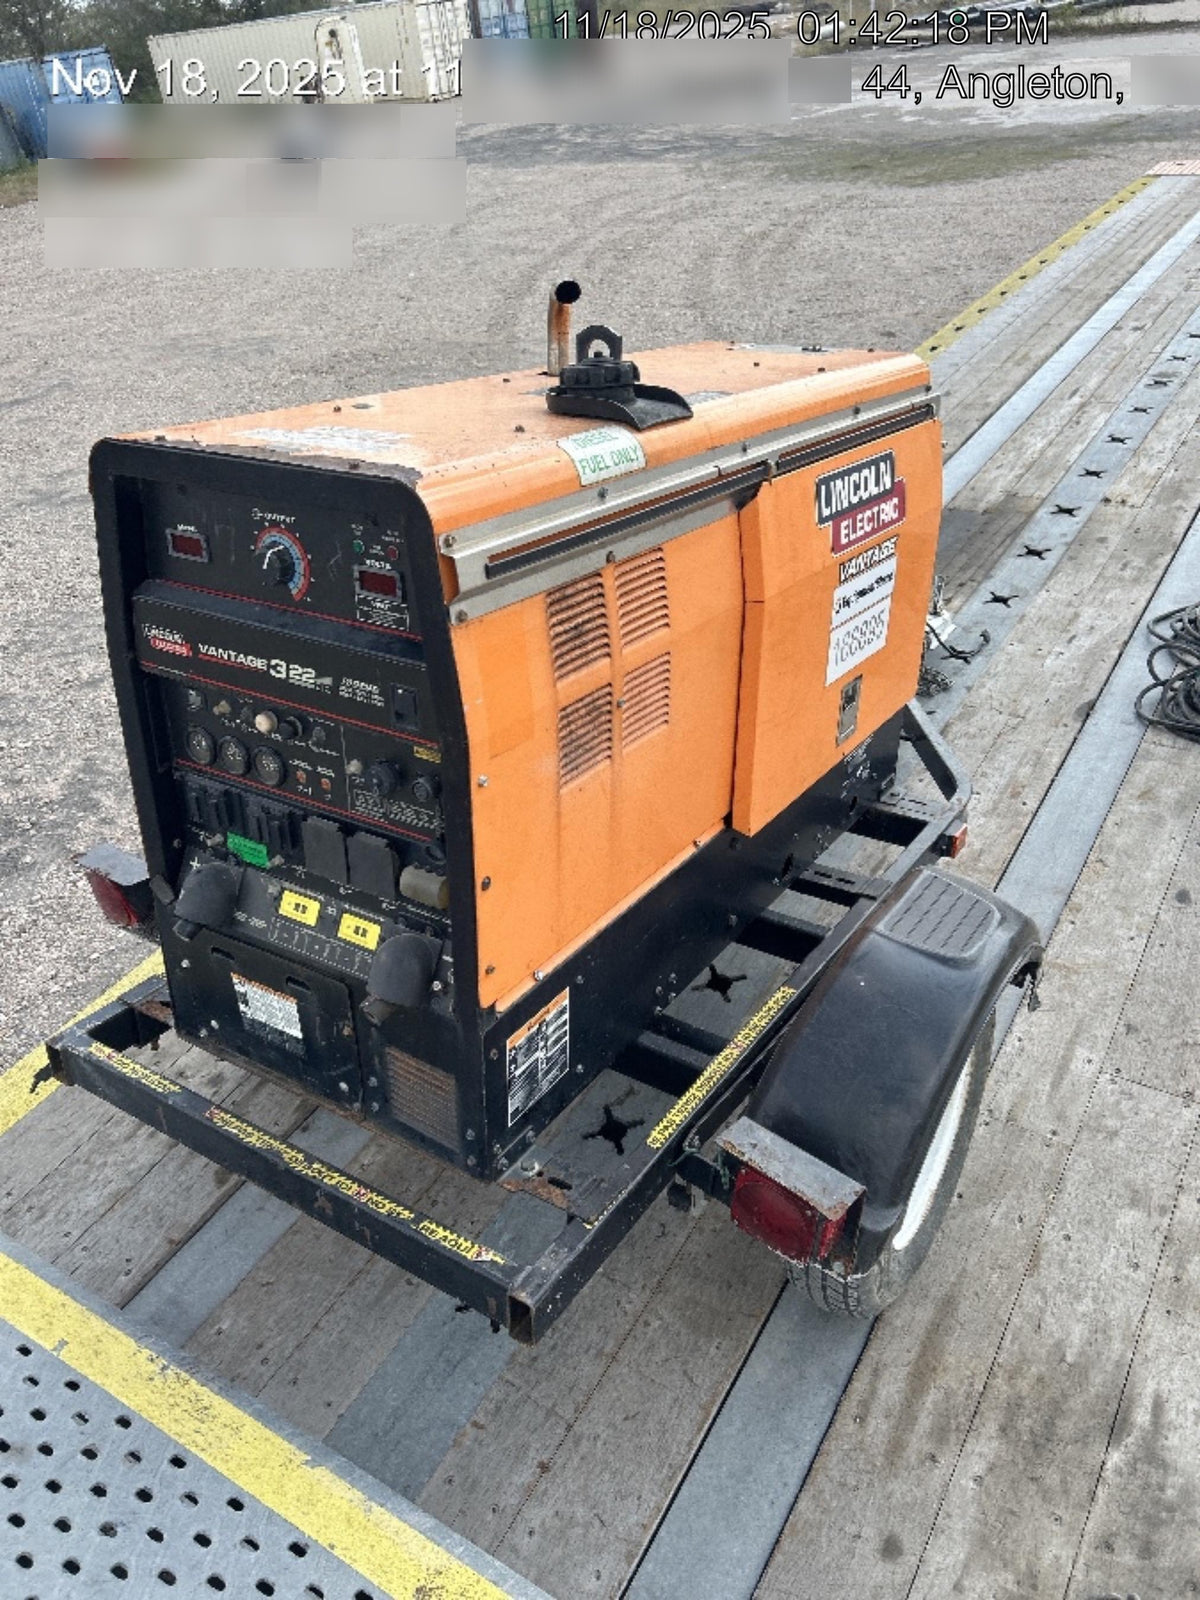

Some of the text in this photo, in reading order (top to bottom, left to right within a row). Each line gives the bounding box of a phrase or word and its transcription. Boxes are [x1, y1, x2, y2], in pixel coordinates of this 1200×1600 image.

[578, 444, 640, 476] FUEL ONLY
[820, 460, 893, 519] LINCOLN
[839, 496, 900, 546] ELECTRIC
[198, 643, 268, 672] VANTAGE
[268, 658, 316, 690] 322
